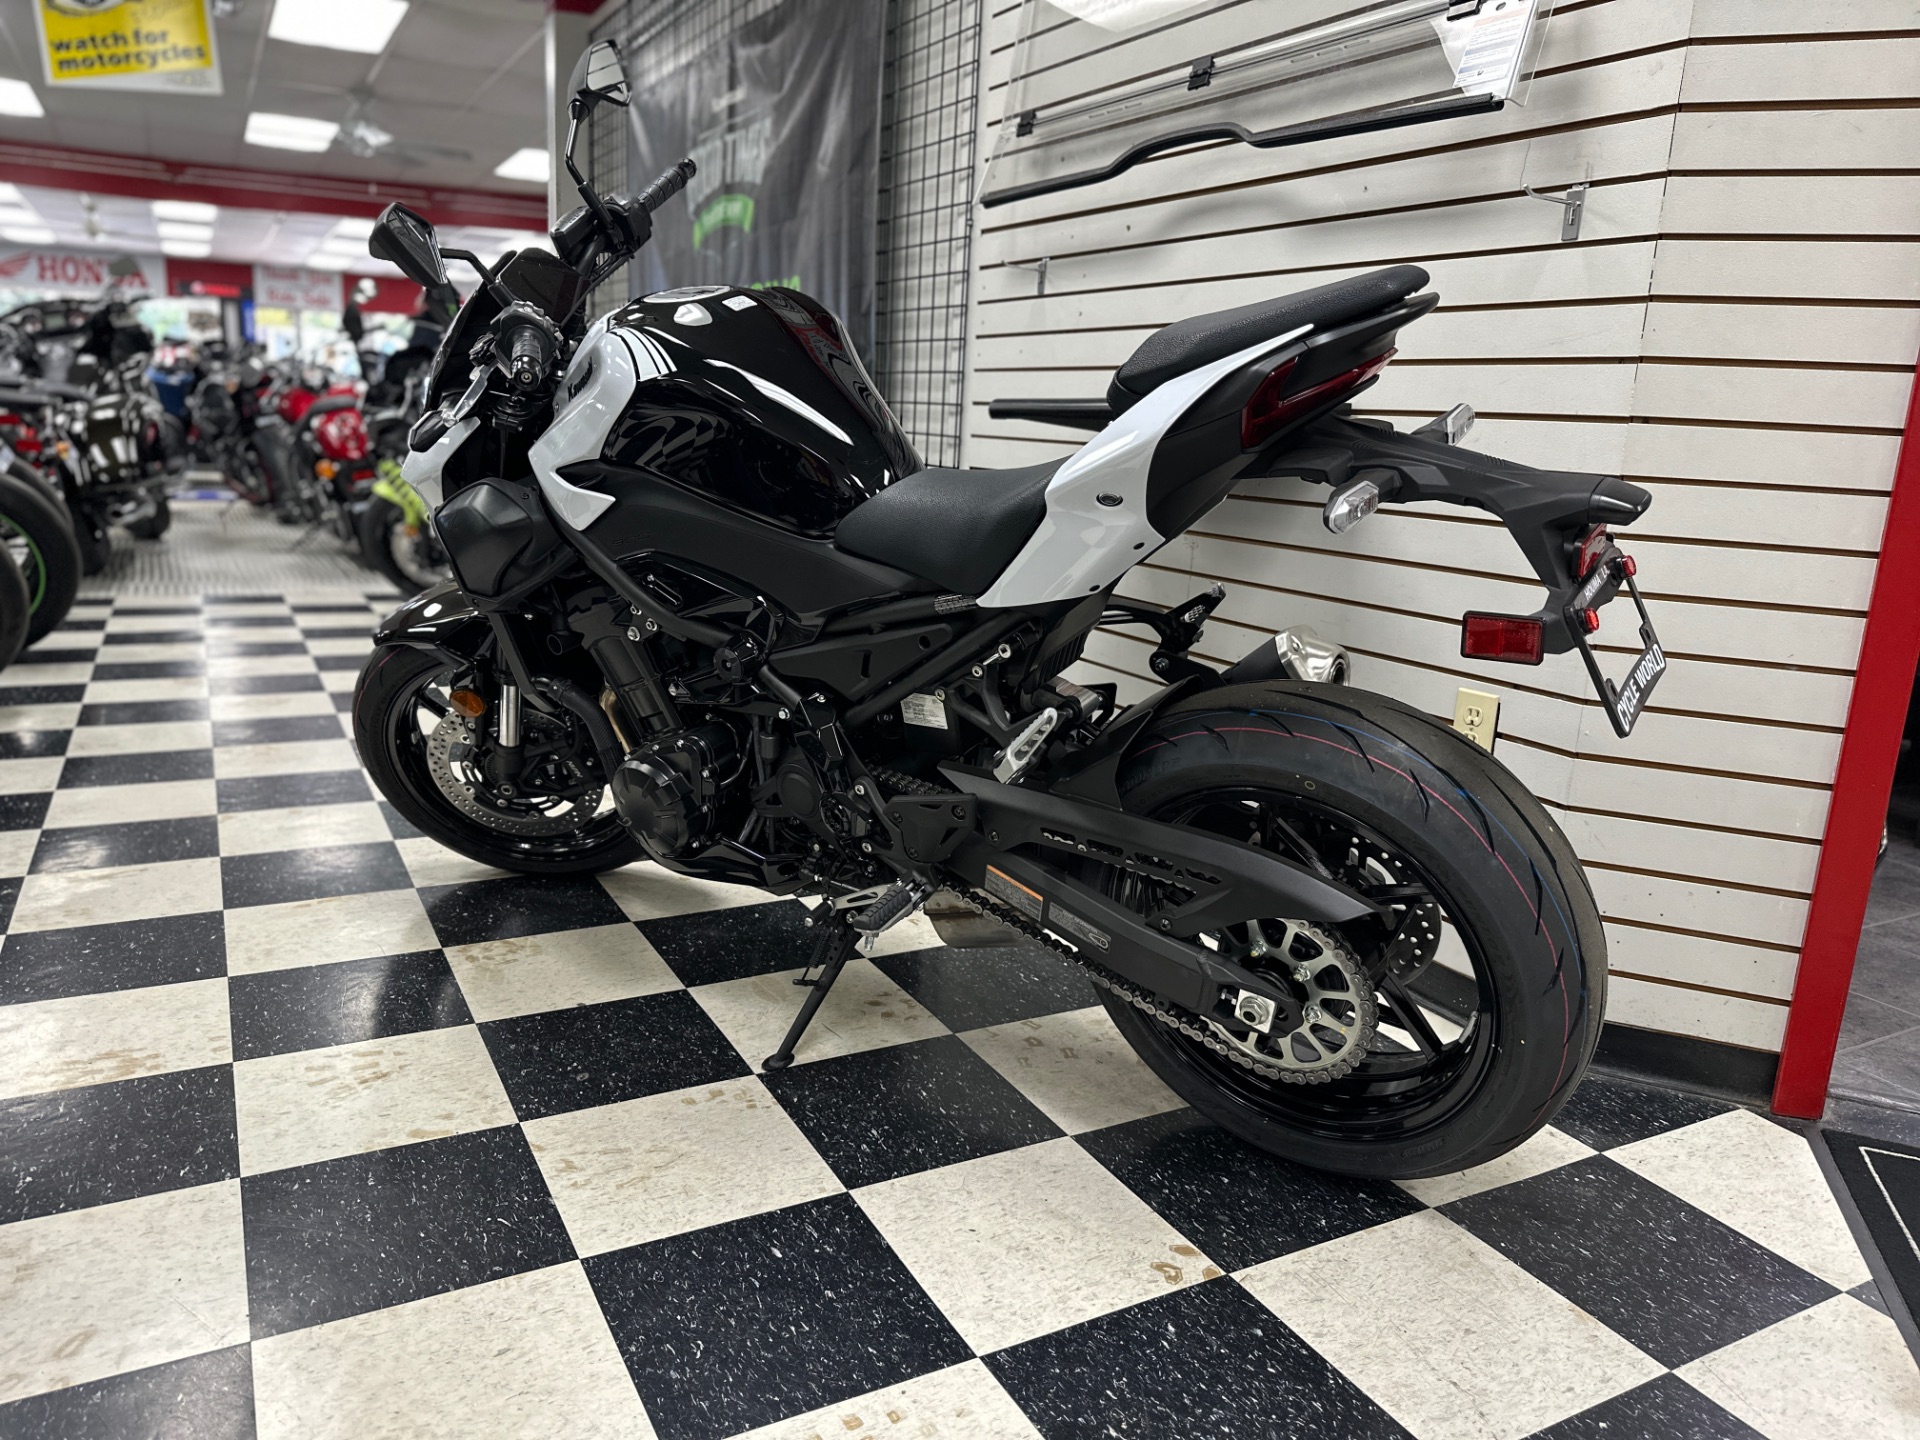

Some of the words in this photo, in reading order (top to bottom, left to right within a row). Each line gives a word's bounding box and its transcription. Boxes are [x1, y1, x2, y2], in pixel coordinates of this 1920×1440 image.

[52, 31, 129, 54] watch
[133, 29, 169, 46] for
[57, 43, 206, 72] motorcycles
[37, 254, 149, 289] HONA
[1617, 678, 1640, 733] CYCLE
[1634, 643, 1665, 689] WORLD
